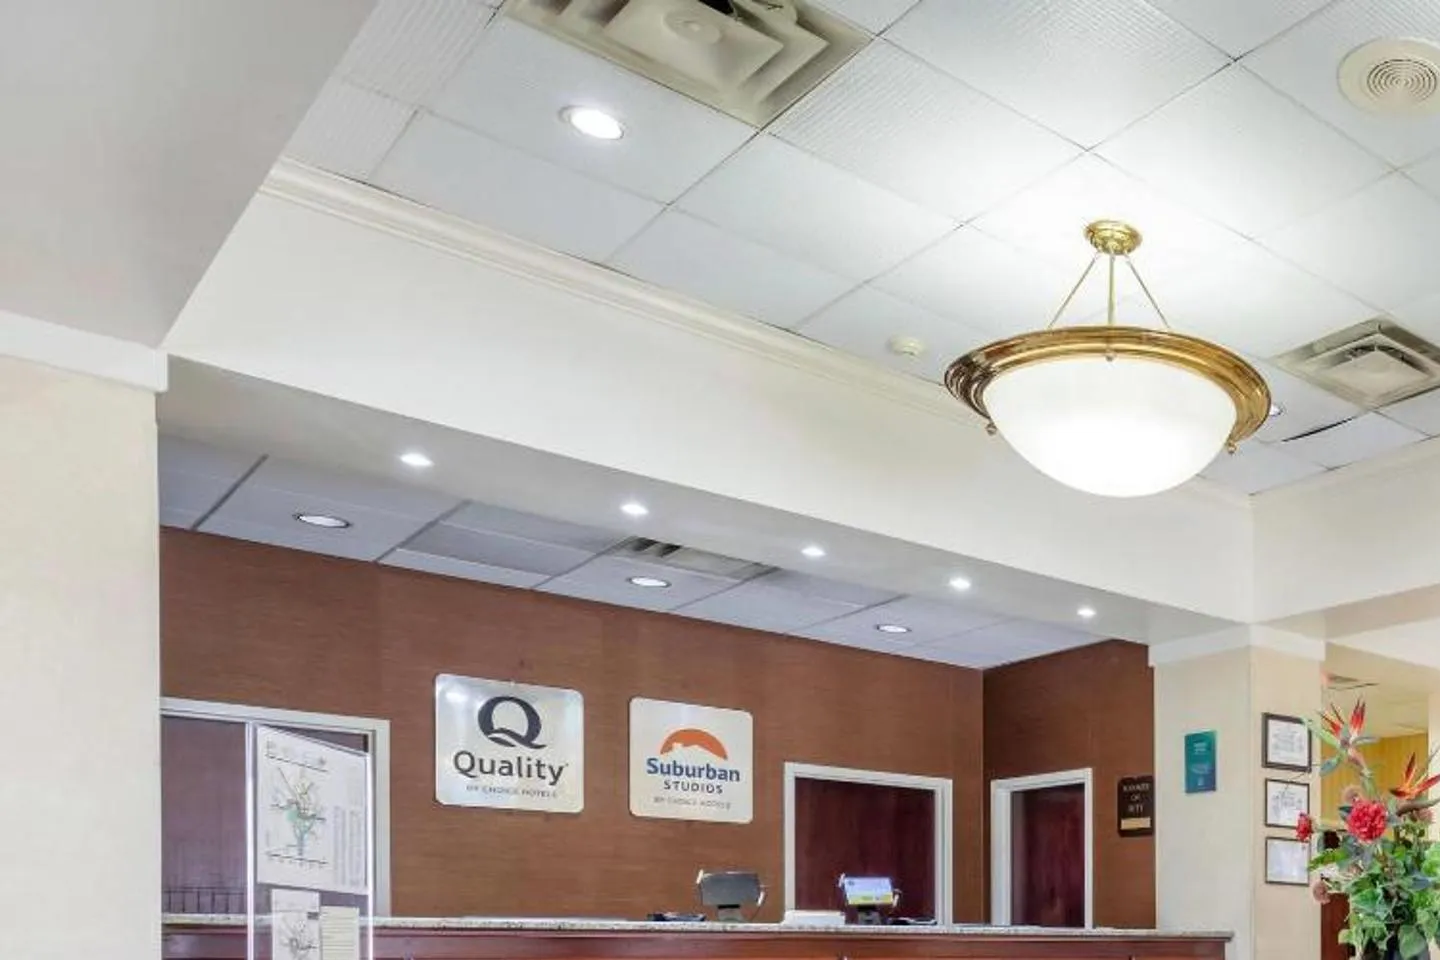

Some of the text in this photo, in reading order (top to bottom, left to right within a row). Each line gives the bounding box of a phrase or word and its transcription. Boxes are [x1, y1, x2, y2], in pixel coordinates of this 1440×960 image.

[453, 750, 565, 786] Quality
[646, 757, 740, 783] Suburban
[663, 779, 723, 795] STUDIOS
